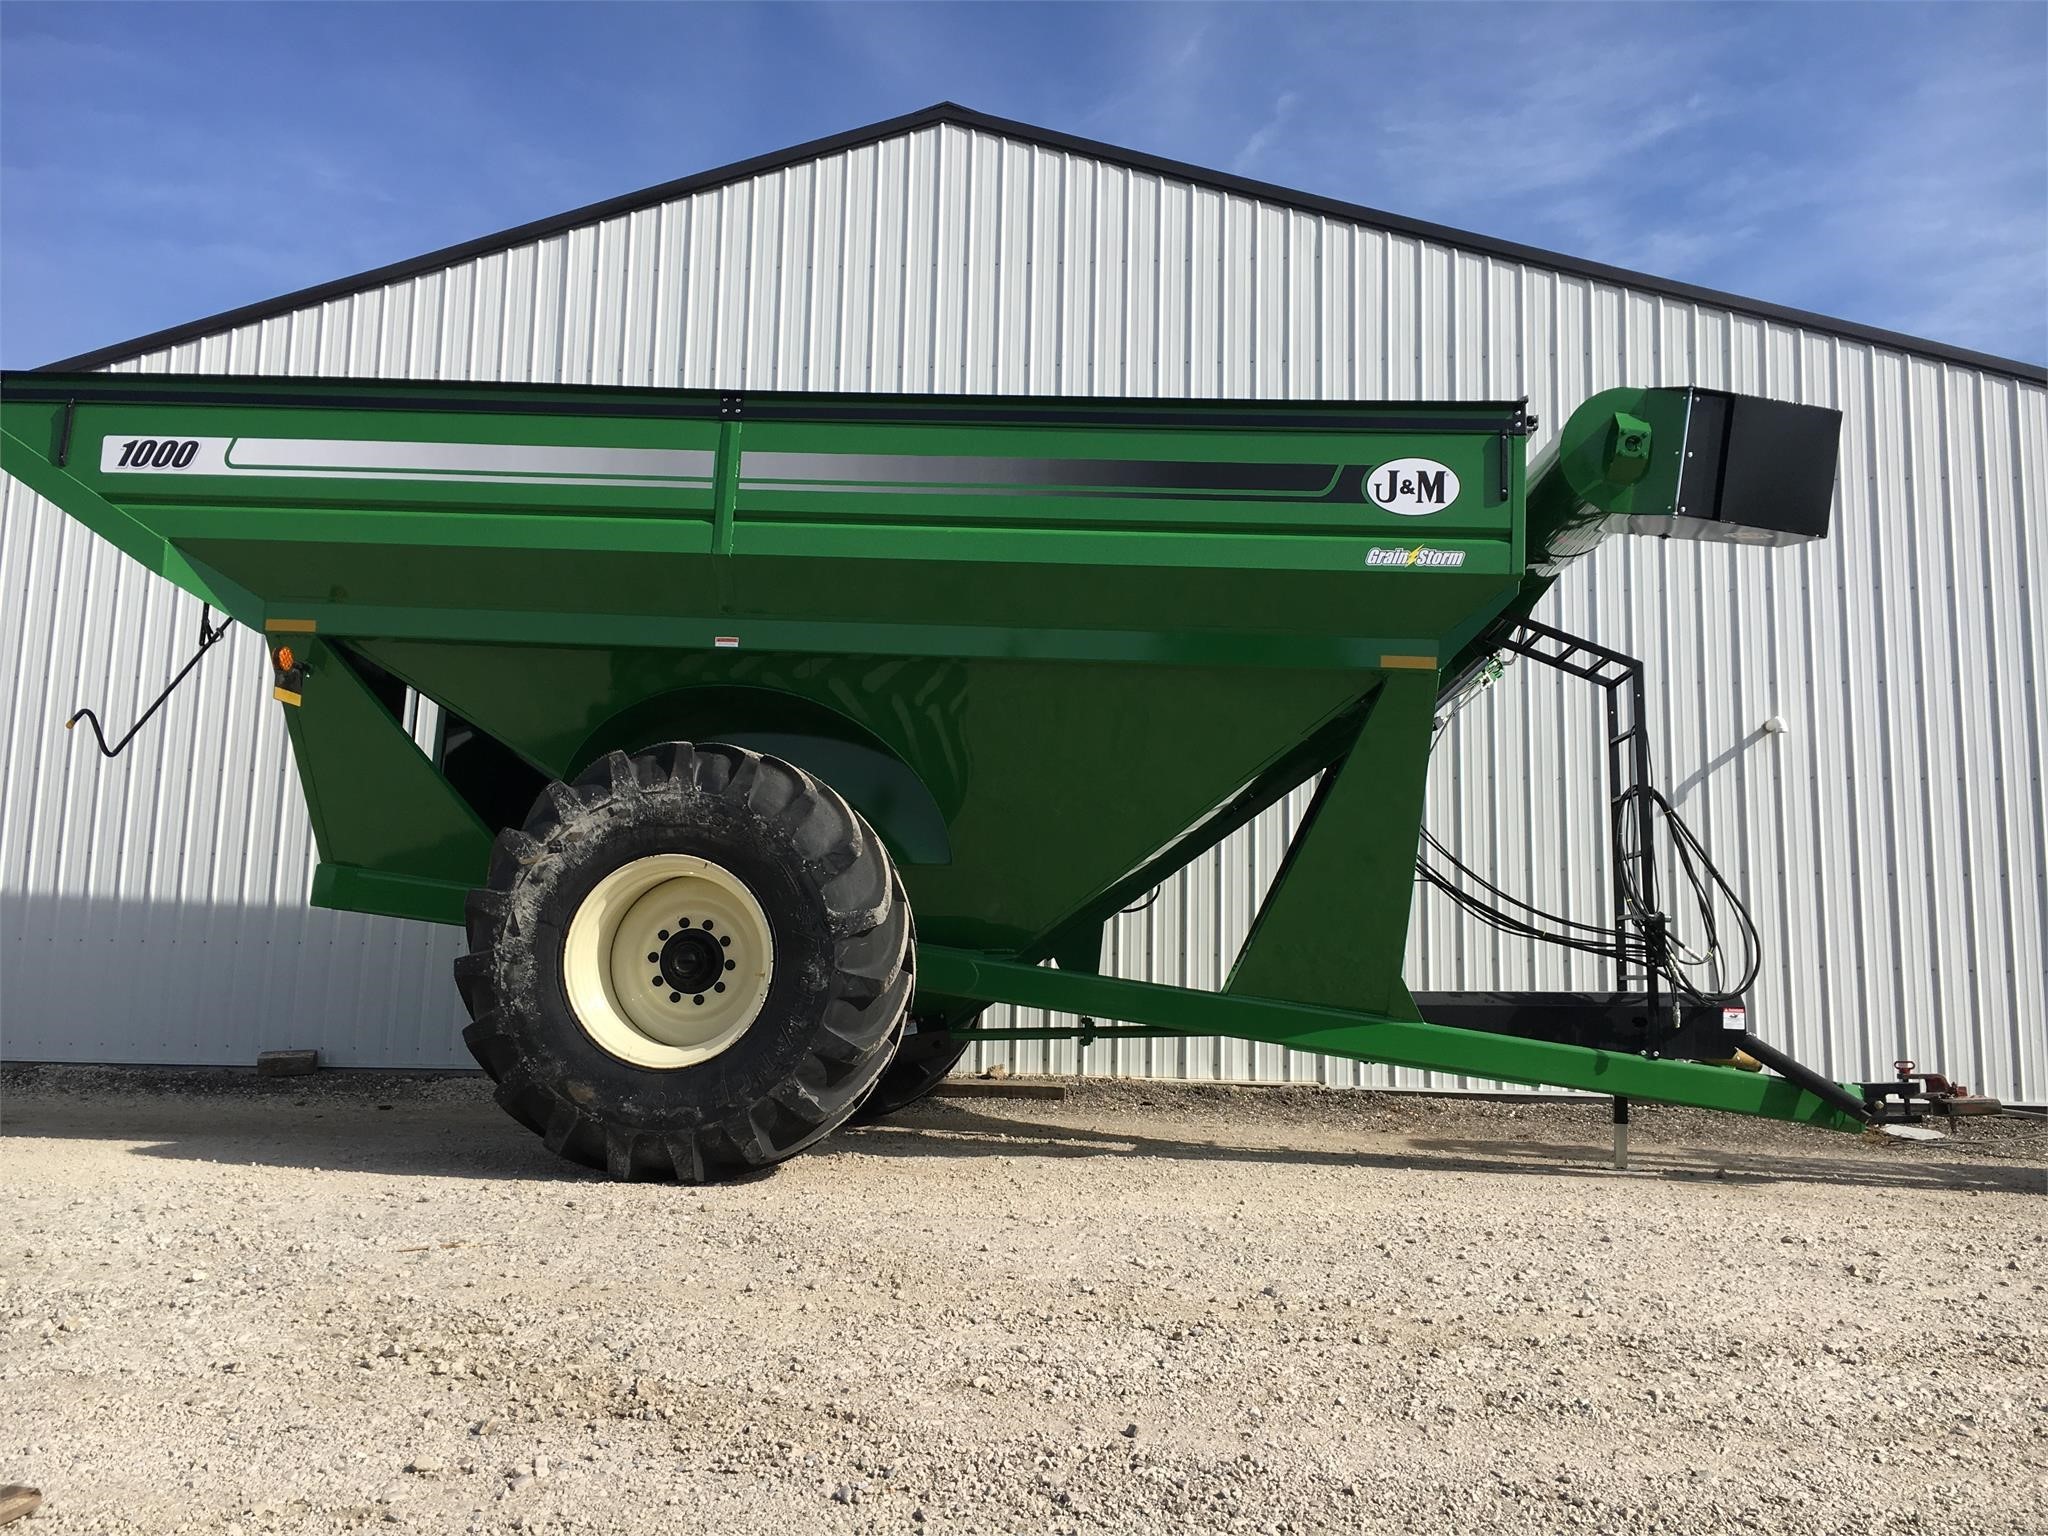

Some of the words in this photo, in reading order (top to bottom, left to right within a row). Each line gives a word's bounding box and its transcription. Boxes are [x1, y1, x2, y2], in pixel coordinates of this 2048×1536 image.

[117, 439, 200, 469] 1000
[1374, 470, 1447, 503] J&M
[1366, 547, 1409, 565] Grain
[1416, 548, 1465, 566] Storm
